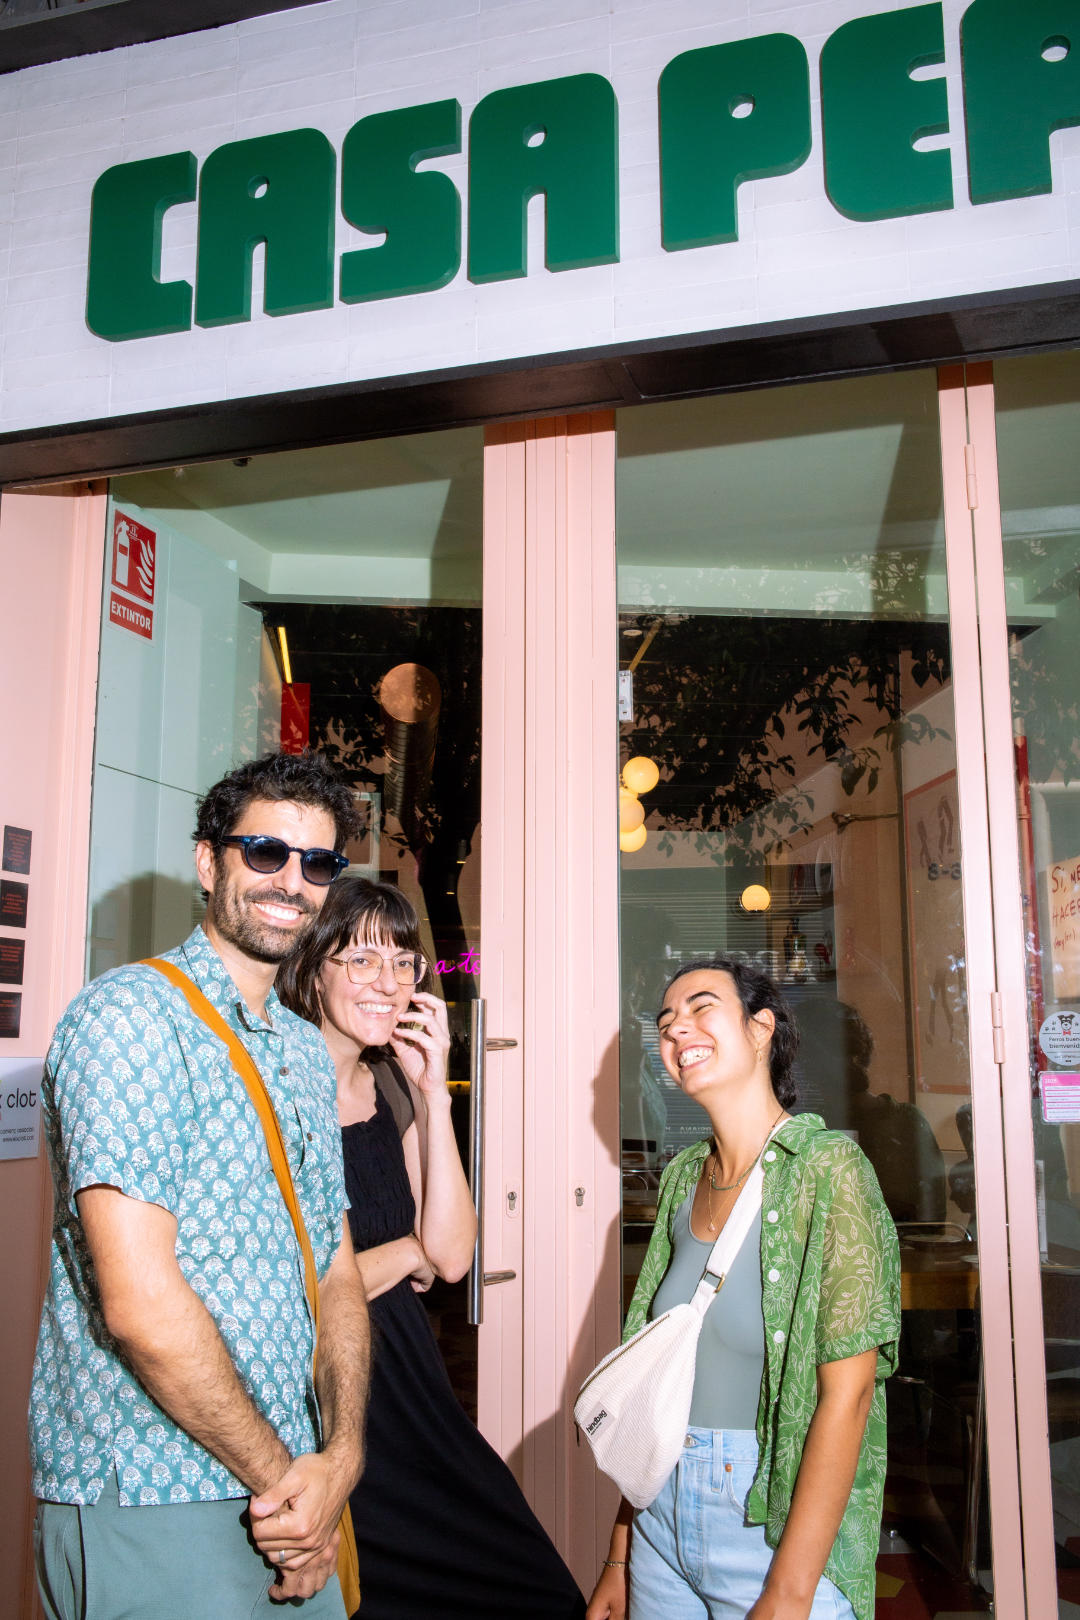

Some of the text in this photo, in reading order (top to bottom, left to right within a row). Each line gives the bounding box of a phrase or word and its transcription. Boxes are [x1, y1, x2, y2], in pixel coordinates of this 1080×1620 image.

[85, 72, 620, 342] CASA
[111, 601, 151, 631] EXTINTOR
[6, 1087, 37, 1109] clot
[586, 1409, 607, 1433] hindbag
